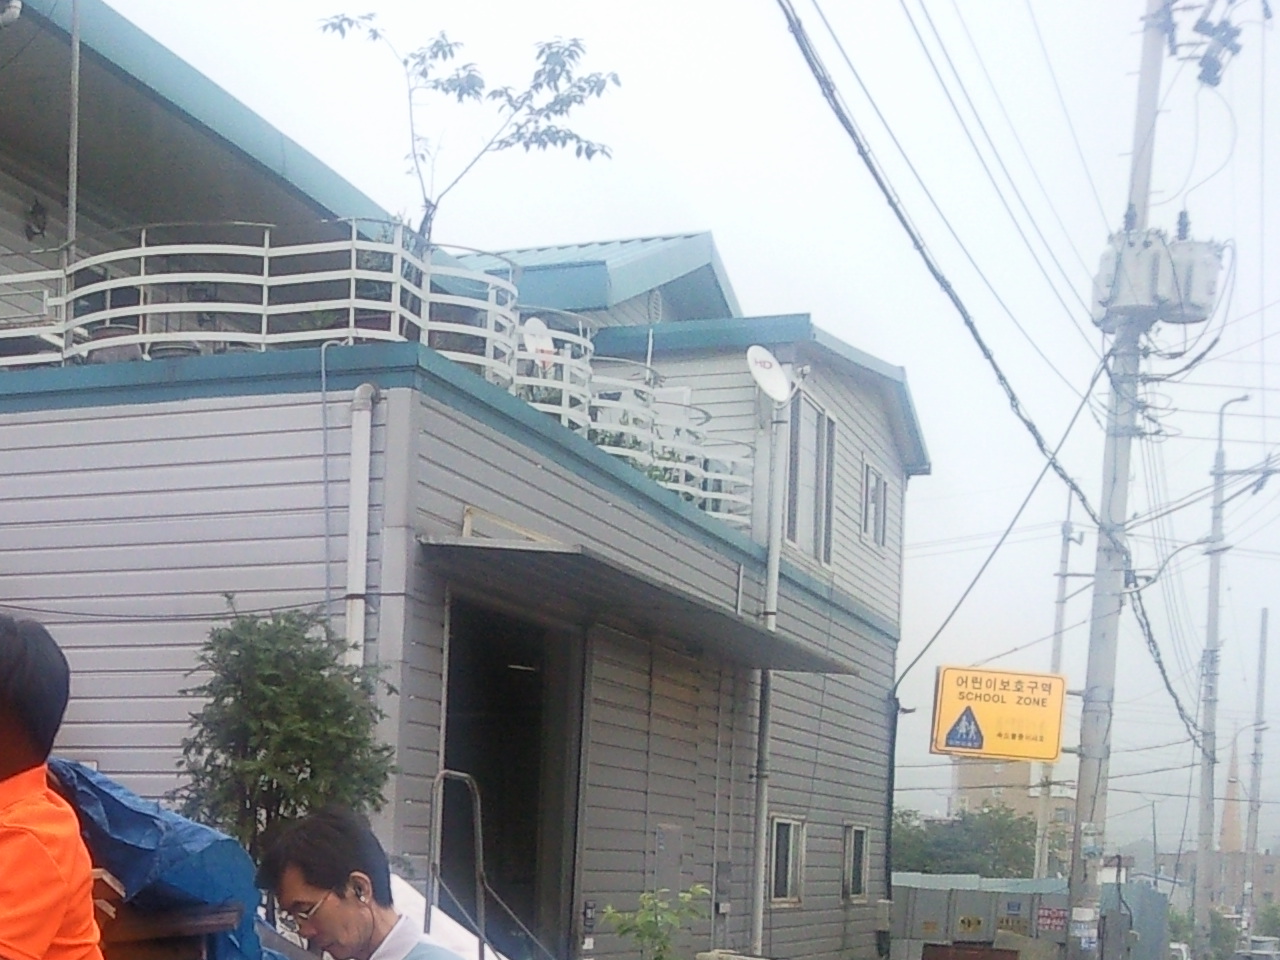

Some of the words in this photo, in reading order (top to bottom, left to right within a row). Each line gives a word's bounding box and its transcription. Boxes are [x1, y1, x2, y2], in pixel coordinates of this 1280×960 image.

[956, 675, 1052, 695] 어린이보호구역
[958, 691, 1007, 704] SCHOOL
[1016, 697, 1047, 707] ZONE
